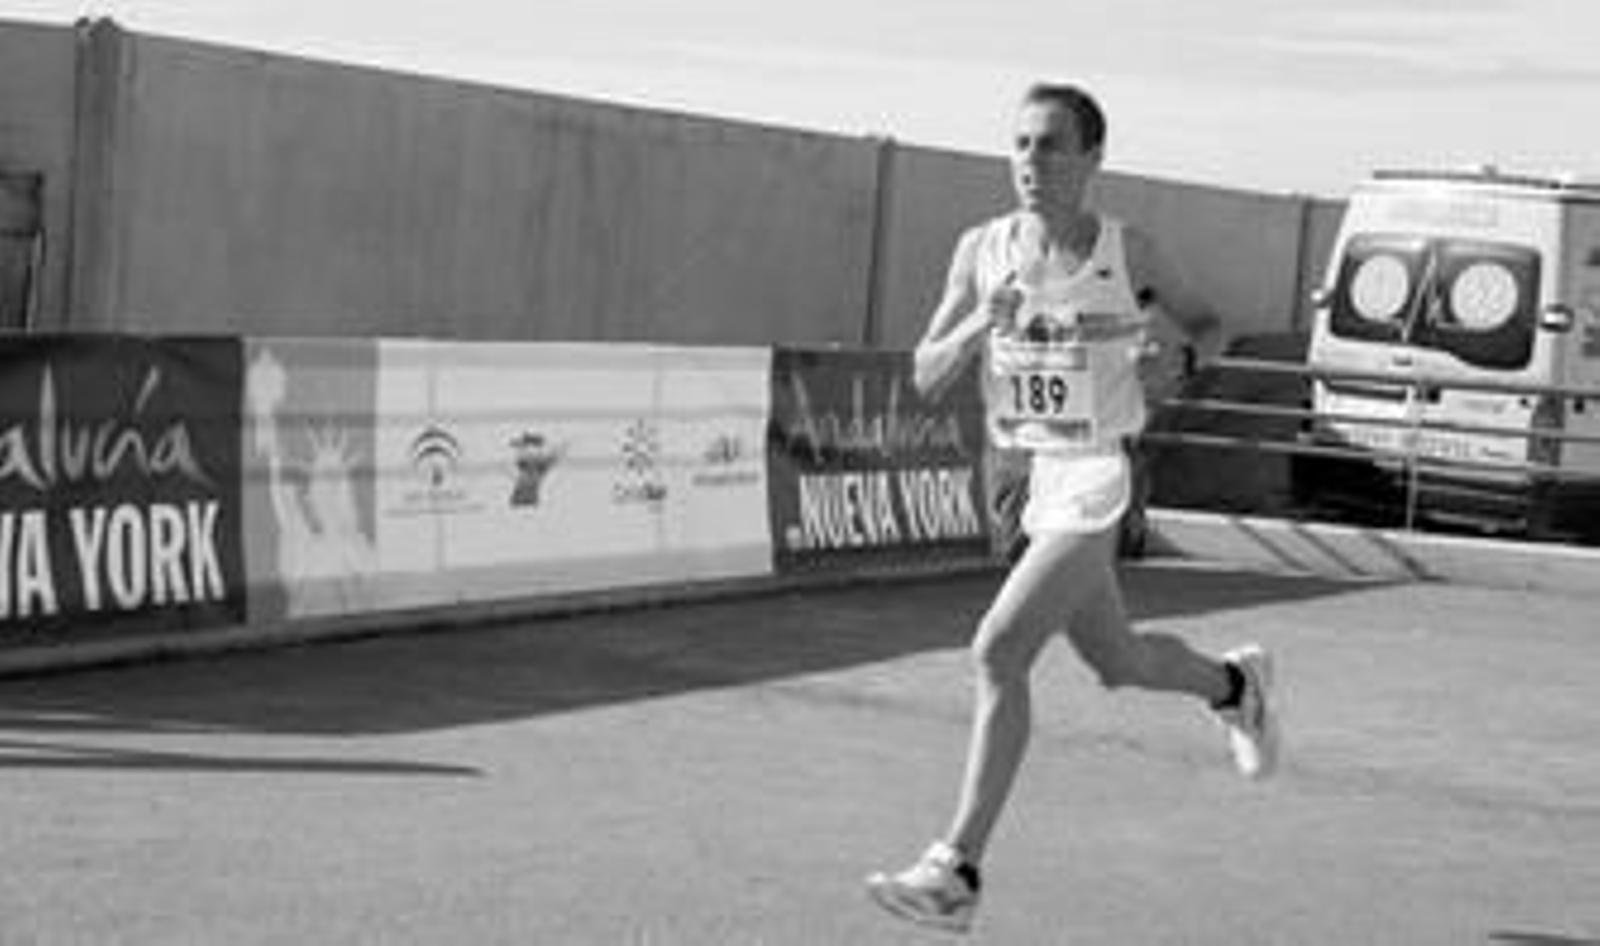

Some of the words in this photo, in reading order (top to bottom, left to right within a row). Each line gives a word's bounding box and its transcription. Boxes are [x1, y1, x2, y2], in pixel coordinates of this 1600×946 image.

[1011, 374, 1068, 415] 189
[799, 472, 900, 549] NUEVA
[899, 465, 979, 541] YORK
[69, 500, 225, 611] YORK
